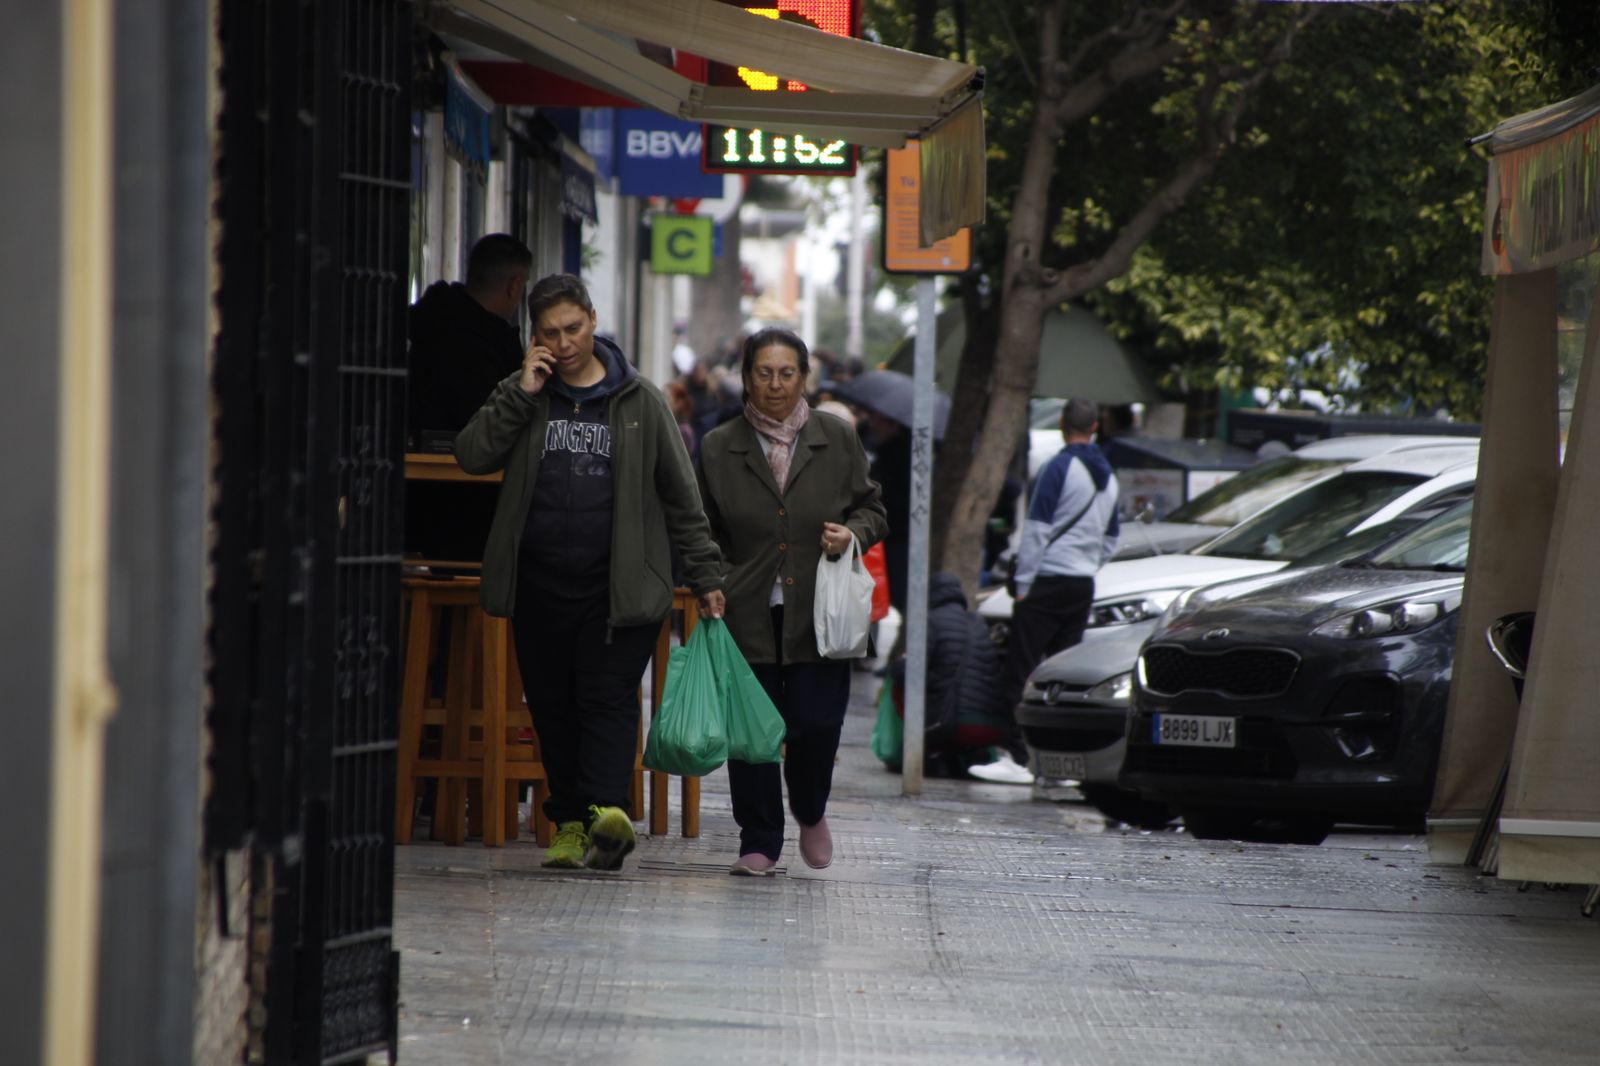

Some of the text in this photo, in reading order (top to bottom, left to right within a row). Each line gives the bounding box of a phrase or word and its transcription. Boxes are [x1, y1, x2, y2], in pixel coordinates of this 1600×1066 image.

[723, 128, 845, 164] 11:52
[667, 229, 697, 259] C
[1162, 719, 1232, 743] 8899 LJX
